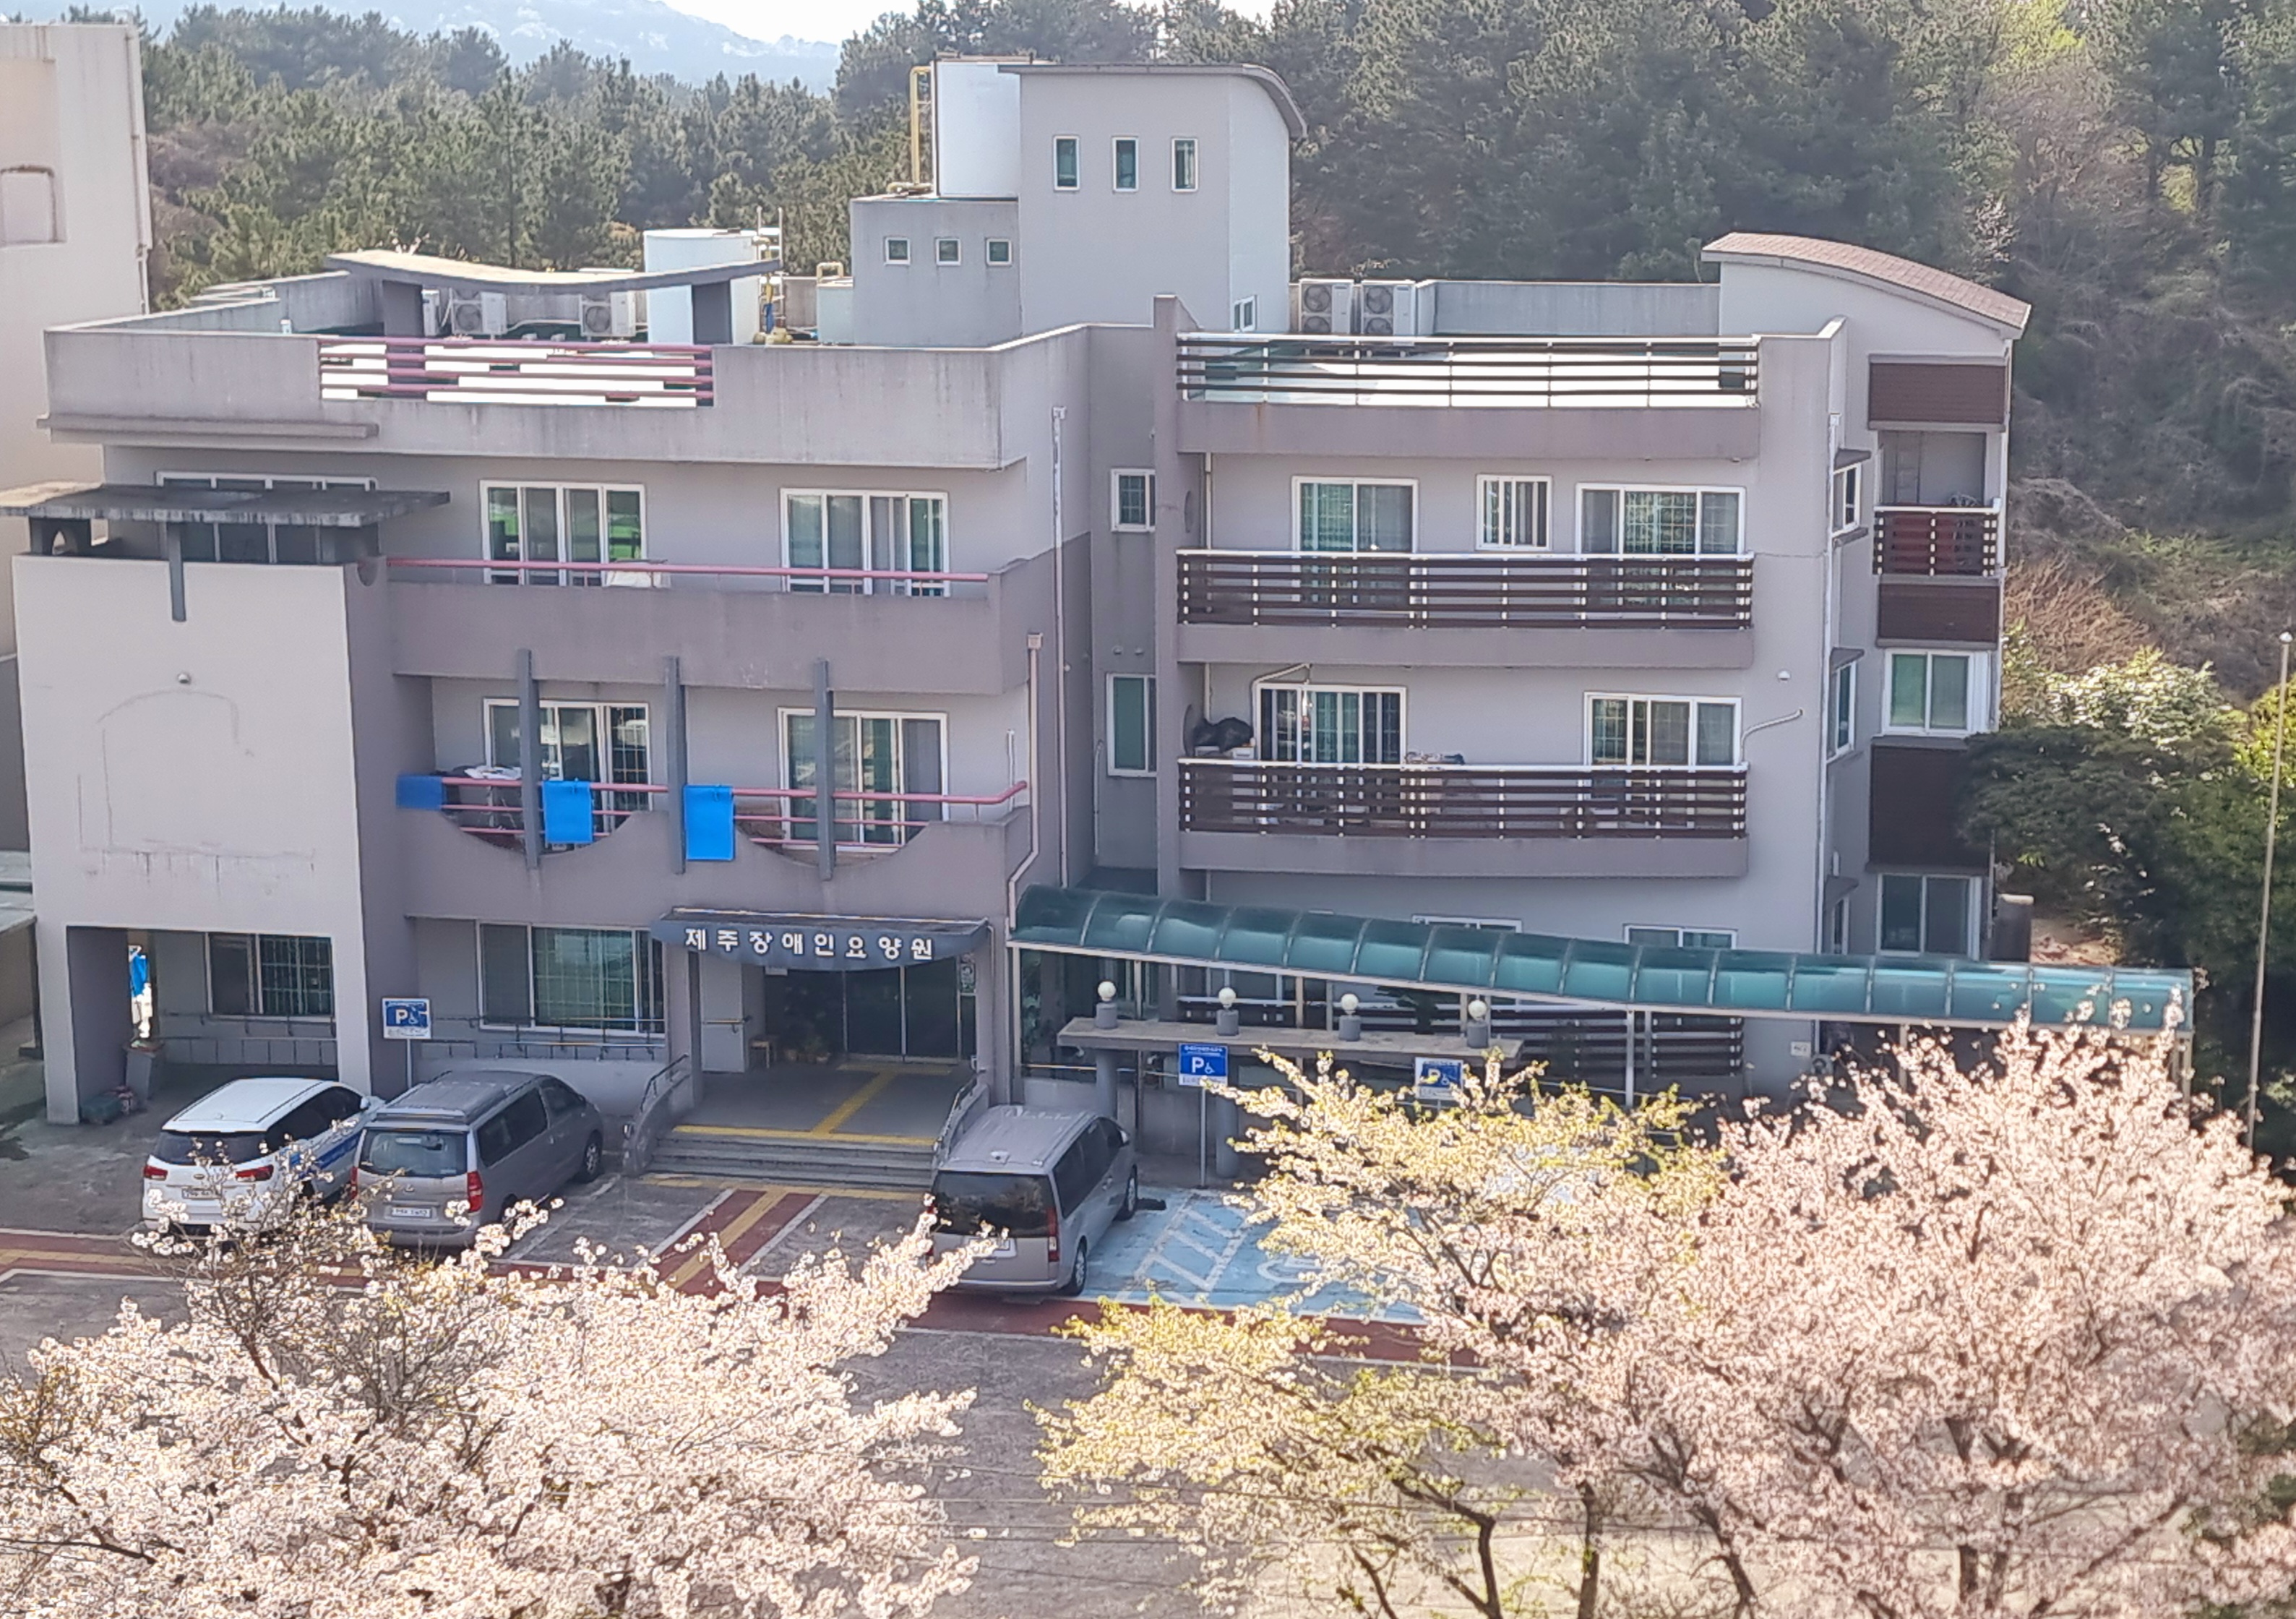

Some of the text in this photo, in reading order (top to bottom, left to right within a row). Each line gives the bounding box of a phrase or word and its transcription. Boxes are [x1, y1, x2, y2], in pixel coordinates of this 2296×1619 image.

[684, 927, 933, 961] 제주장애인요양원
[395, 1009, 408, 1024] P
[1192, 1057, 1205, 1073] P
